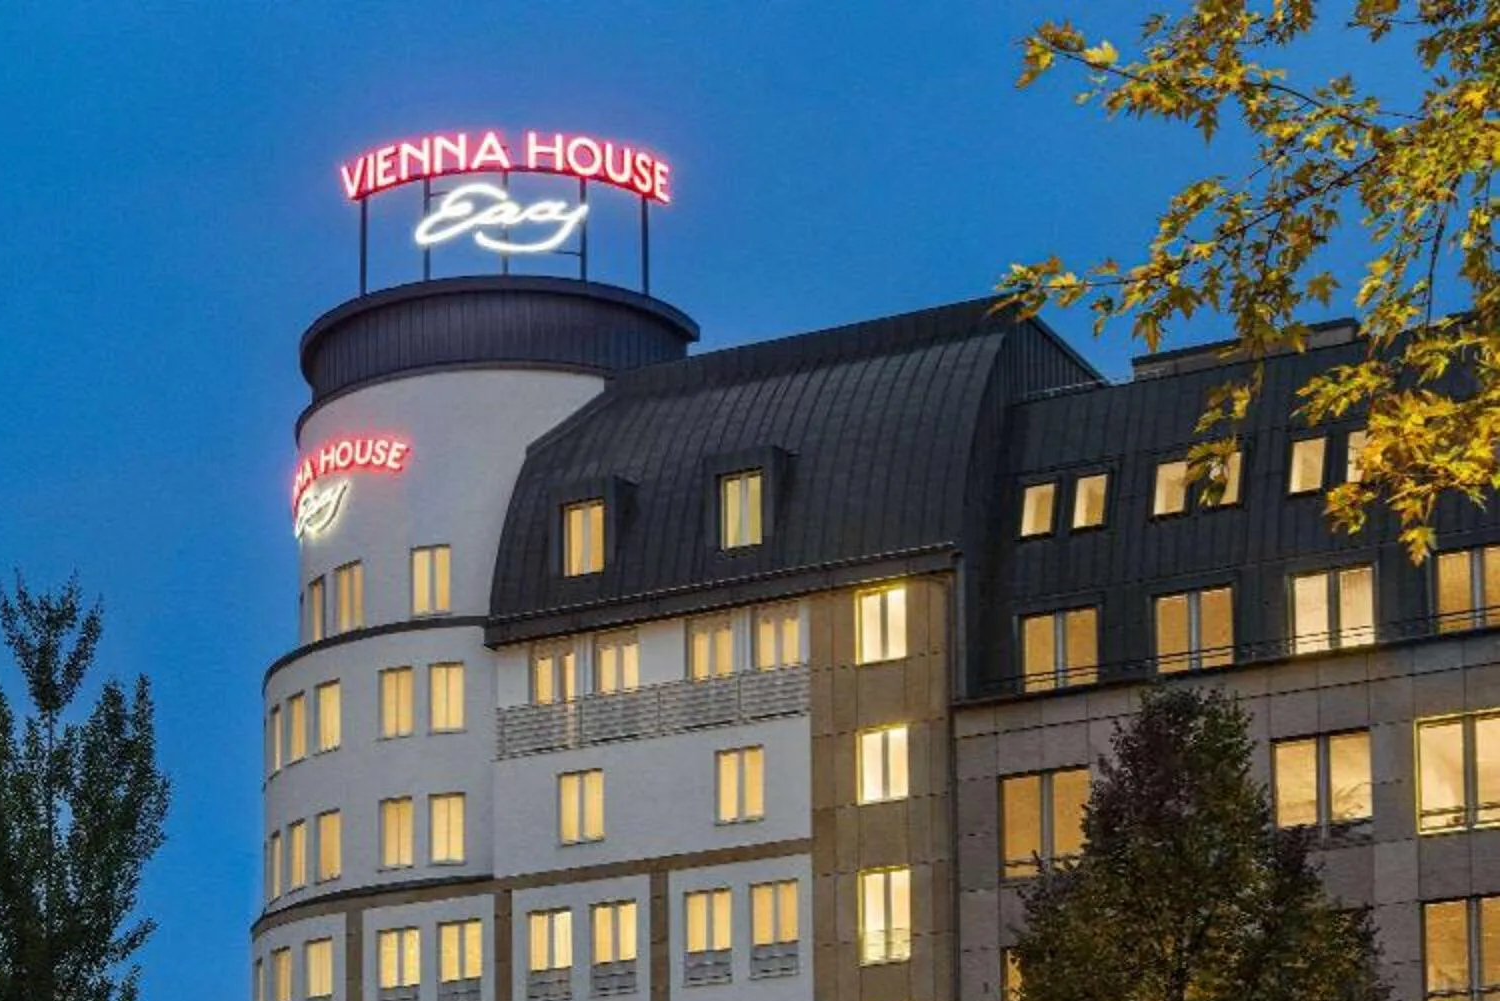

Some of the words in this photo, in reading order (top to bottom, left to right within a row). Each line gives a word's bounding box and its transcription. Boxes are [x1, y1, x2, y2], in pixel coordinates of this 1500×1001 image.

[340, 131, 511, 199] VIENNA
[527, 131, 671, 204] HOUSE
[414, 183, 590, 253] Easy
[319, 438, 408, 475] HOUSE
